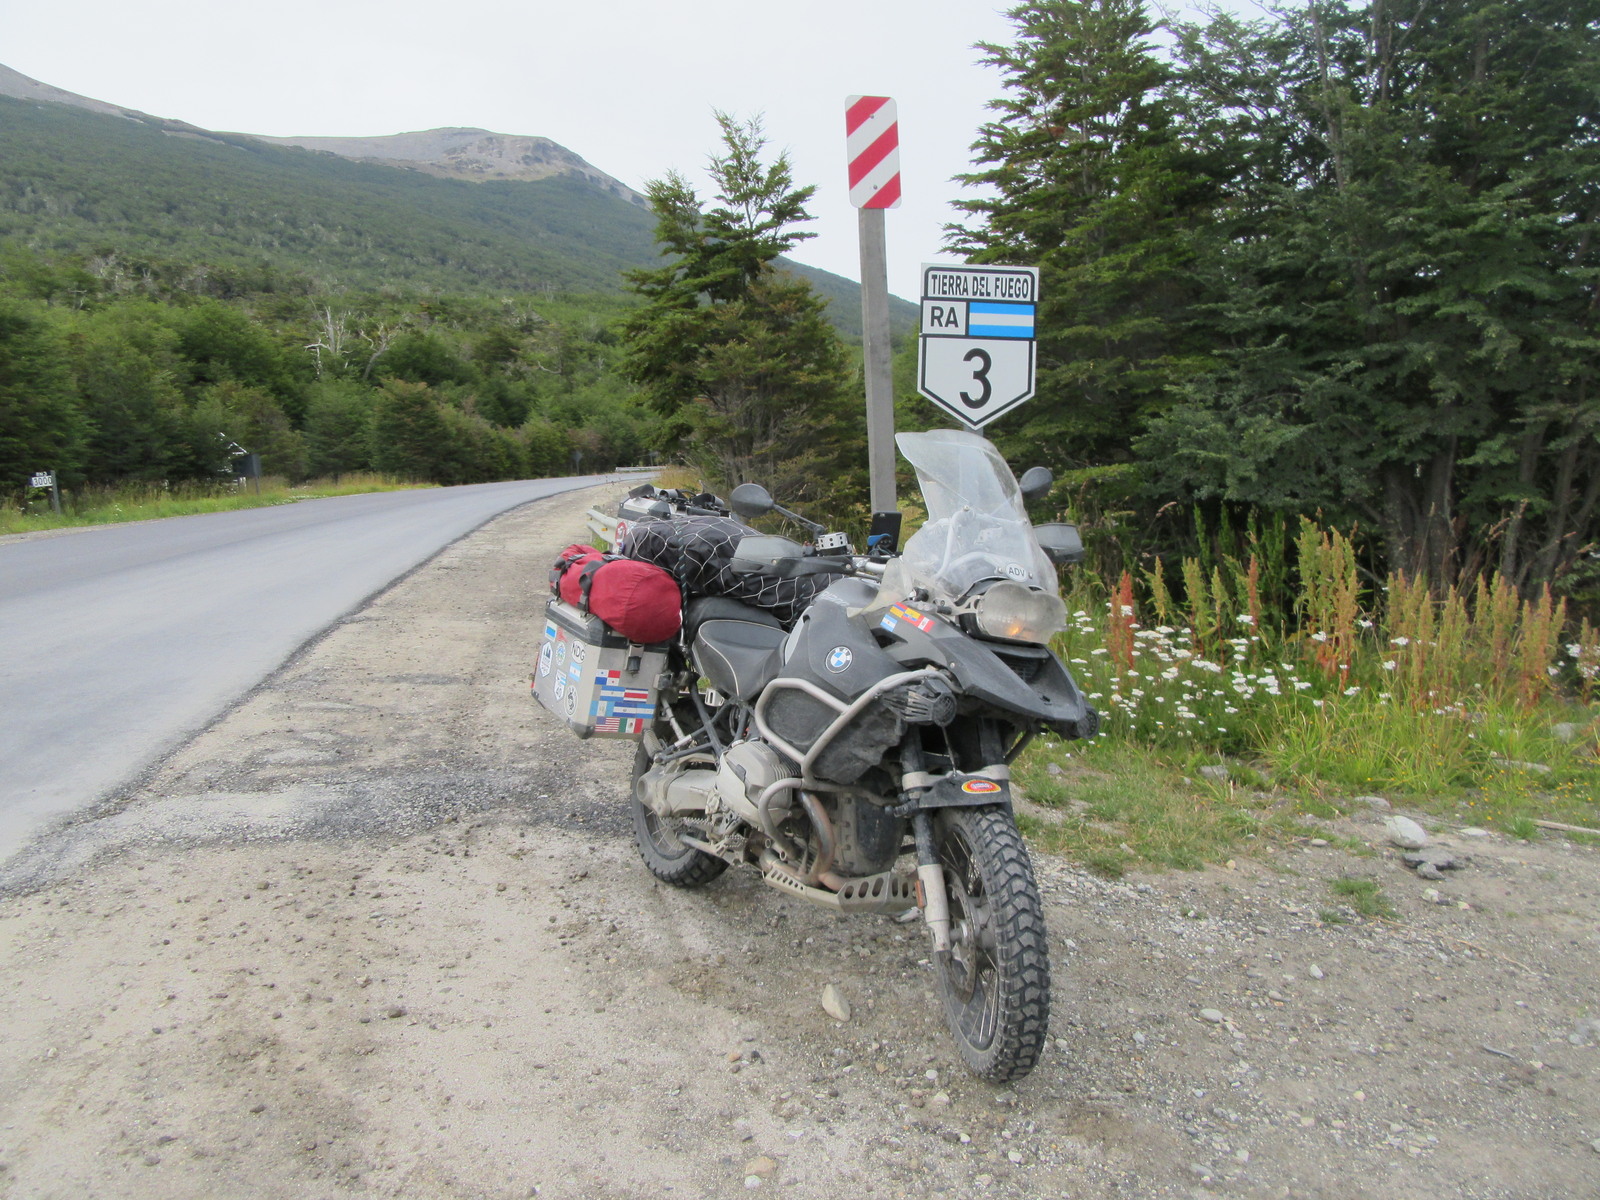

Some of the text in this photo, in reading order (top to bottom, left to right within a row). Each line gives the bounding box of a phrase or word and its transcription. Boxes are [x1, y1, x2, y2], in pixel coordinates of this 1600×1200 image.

[931, 274, 1029, 299] TIERRA DEL FUEGO
[930, 306, 959, 328] RA
[959, 347, 992, 409] 3
[1008, 566, 1024, 577] ADV
